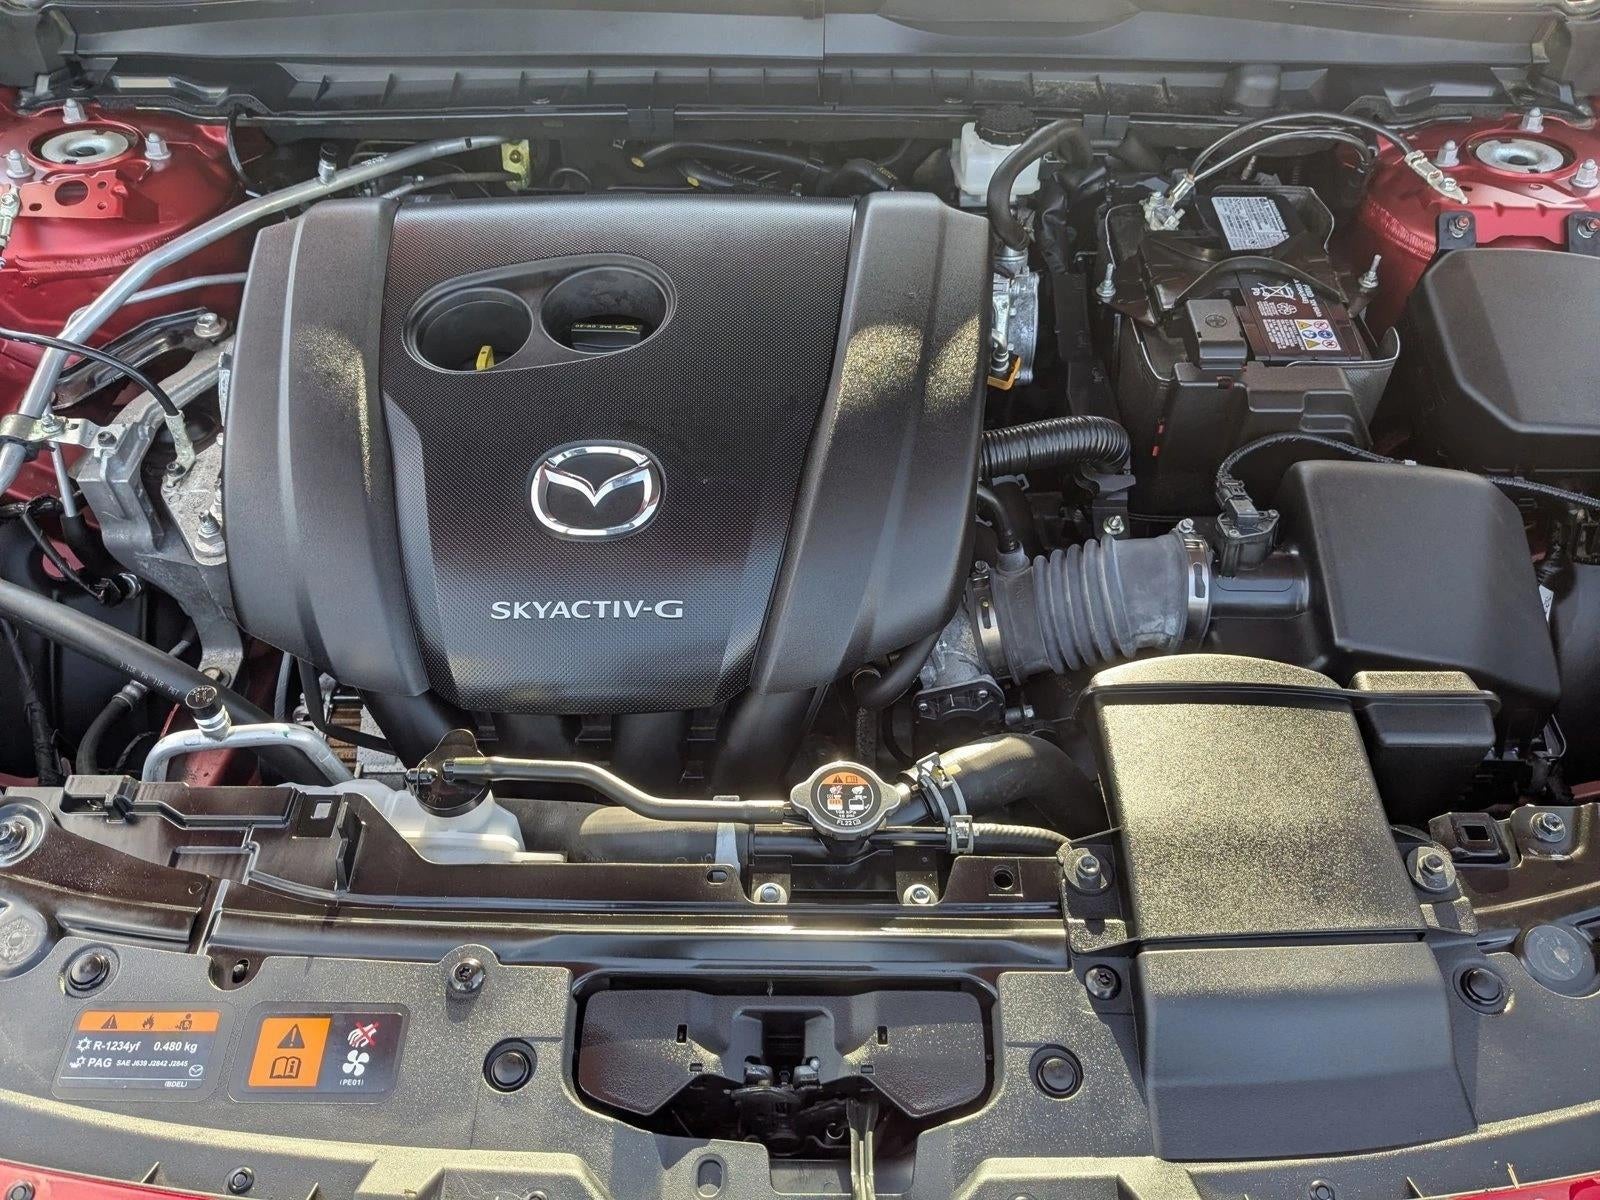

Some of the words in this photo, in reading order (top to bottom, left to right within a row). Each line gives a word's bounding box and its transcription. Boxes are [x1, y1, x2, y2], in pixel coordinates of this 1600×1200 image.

[490, 600, 684, 620] SKYACTIV-G
[93, 1041, 142, 1052] R-1234yf
[153, 1041, 182, 1052] 0.480
[184, 1042, 198, 1053] kg
[87, 1058, 112, 1068] PAG
[116, 1059, 132, 1067] SAE
